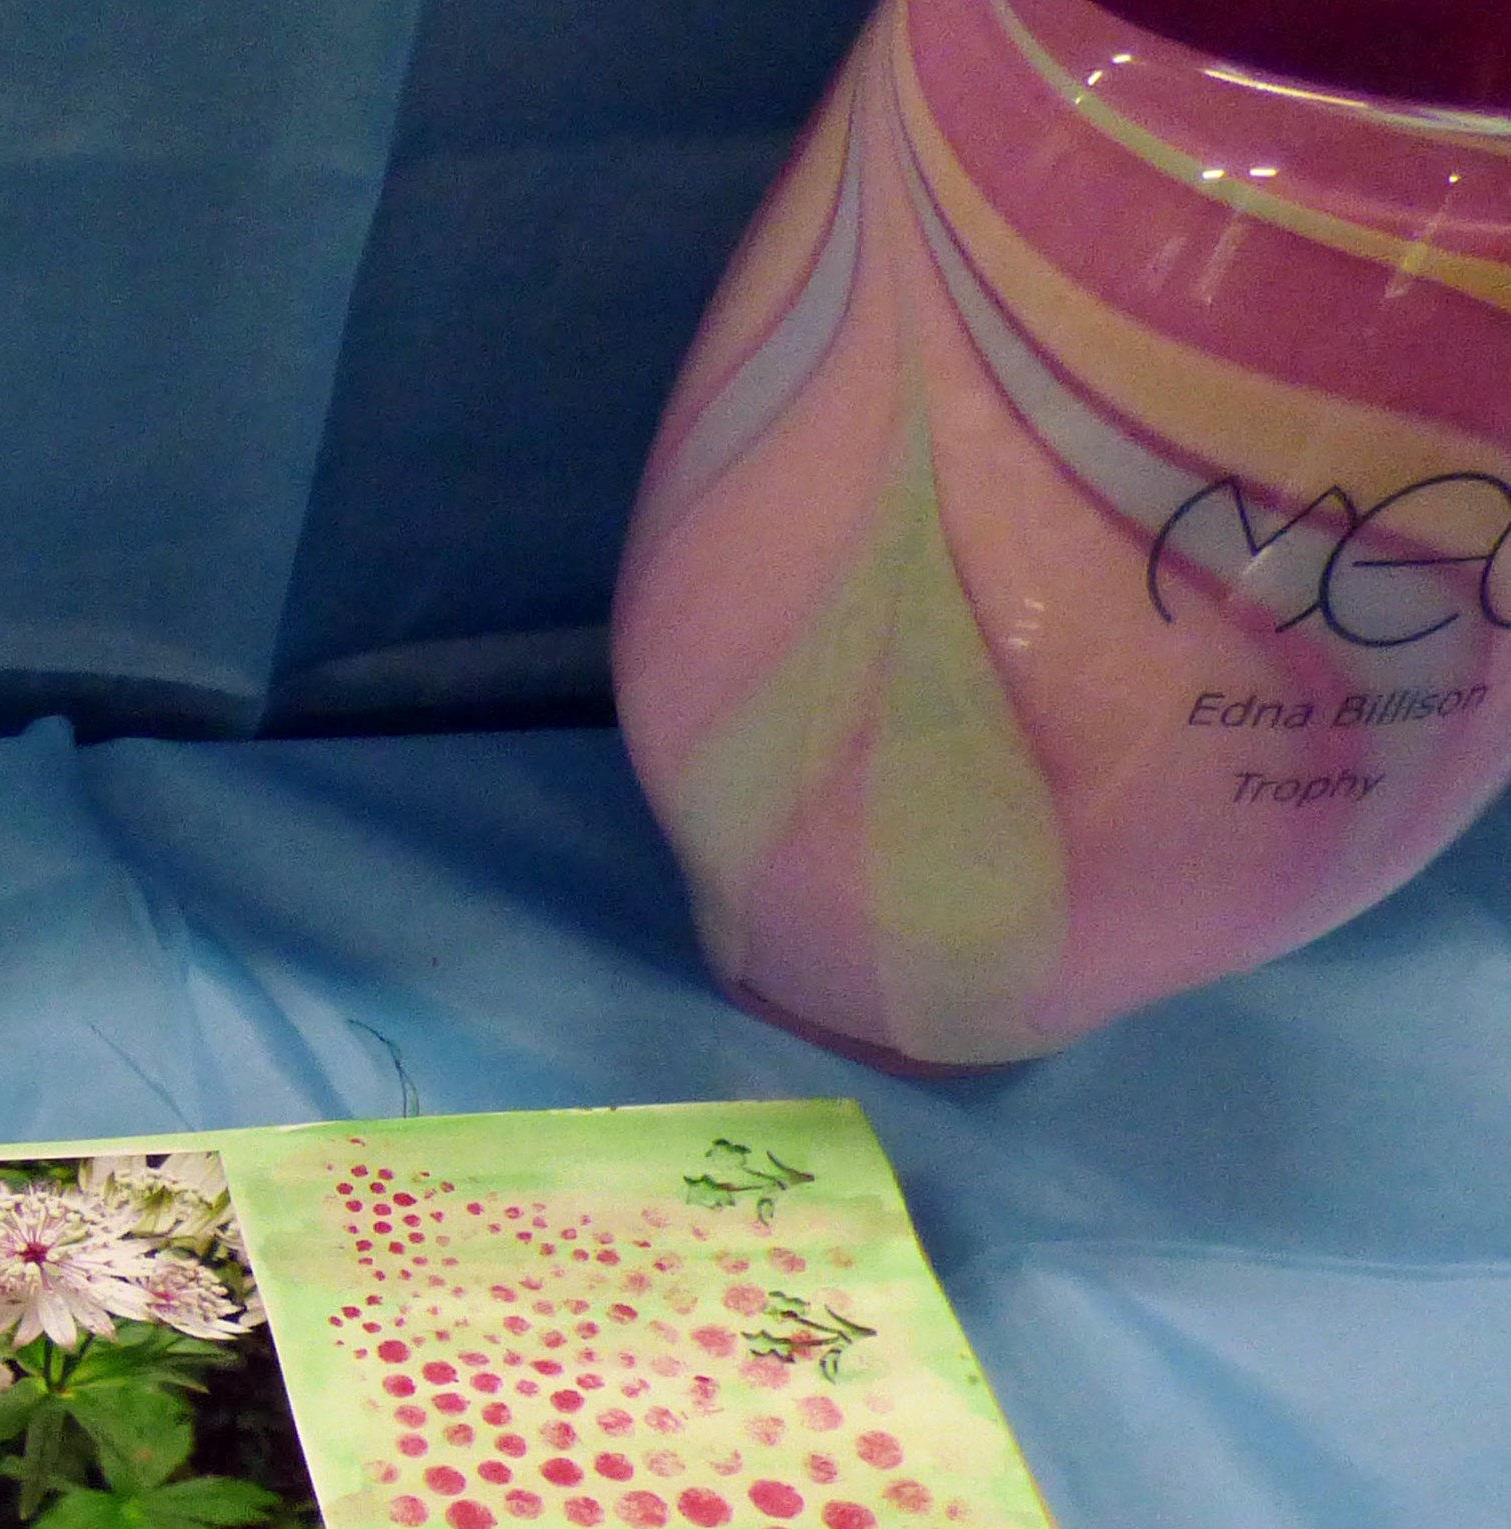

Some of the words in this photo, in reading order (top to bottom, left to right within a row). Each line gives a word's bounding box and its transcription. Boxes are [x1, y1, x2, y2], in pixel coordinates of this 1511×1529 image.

[1188, 691, 1313, 730] Edna
[1331, 683, 1488, 729] Billison
[1234, 771, 1385, 807] Trophy
